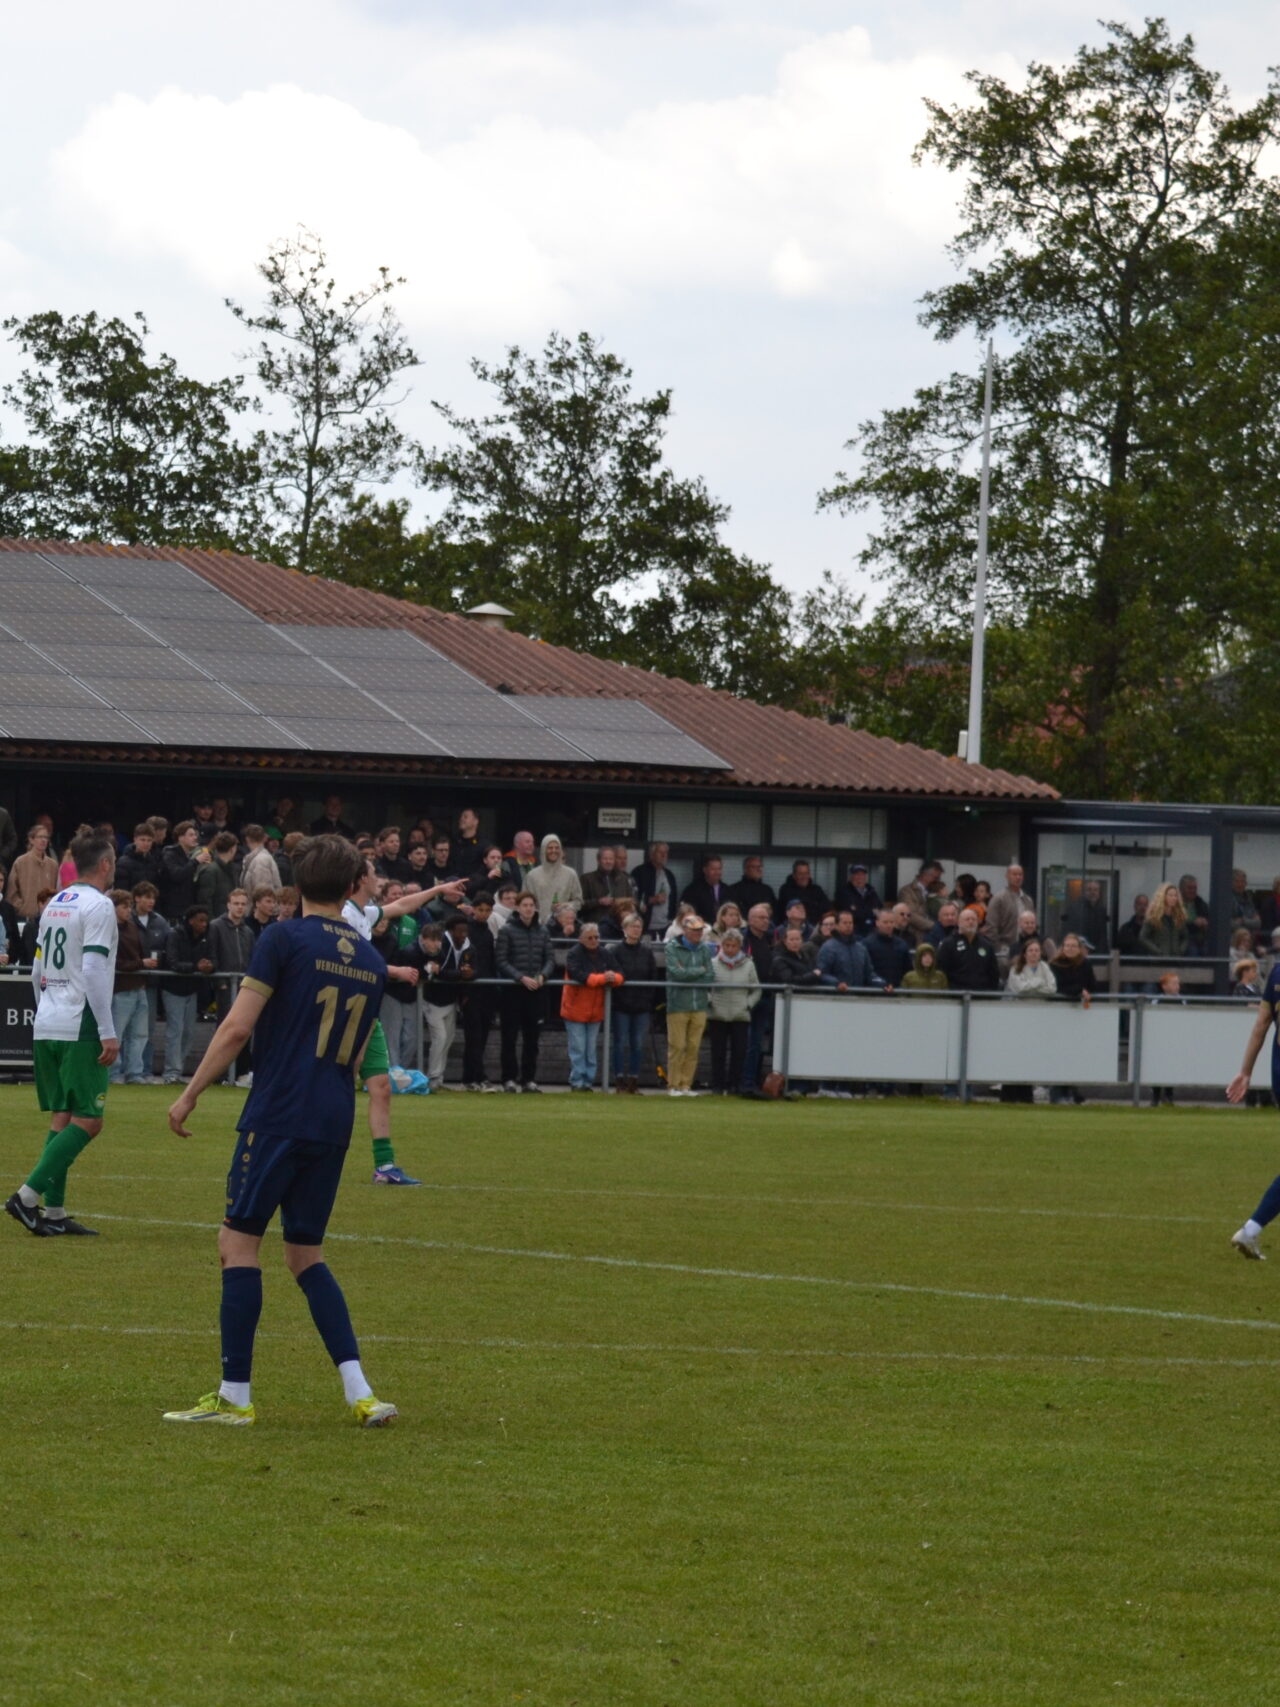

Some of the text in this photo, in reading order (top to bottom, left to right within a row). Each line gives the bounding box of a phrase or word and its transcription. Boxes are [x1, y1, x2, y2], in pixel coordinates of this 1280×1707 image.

[43, 926, 67, 970] 18
[316, 960, 377, 985] VERZEKERINGEN
[316, 985, 368, 1066] 11
